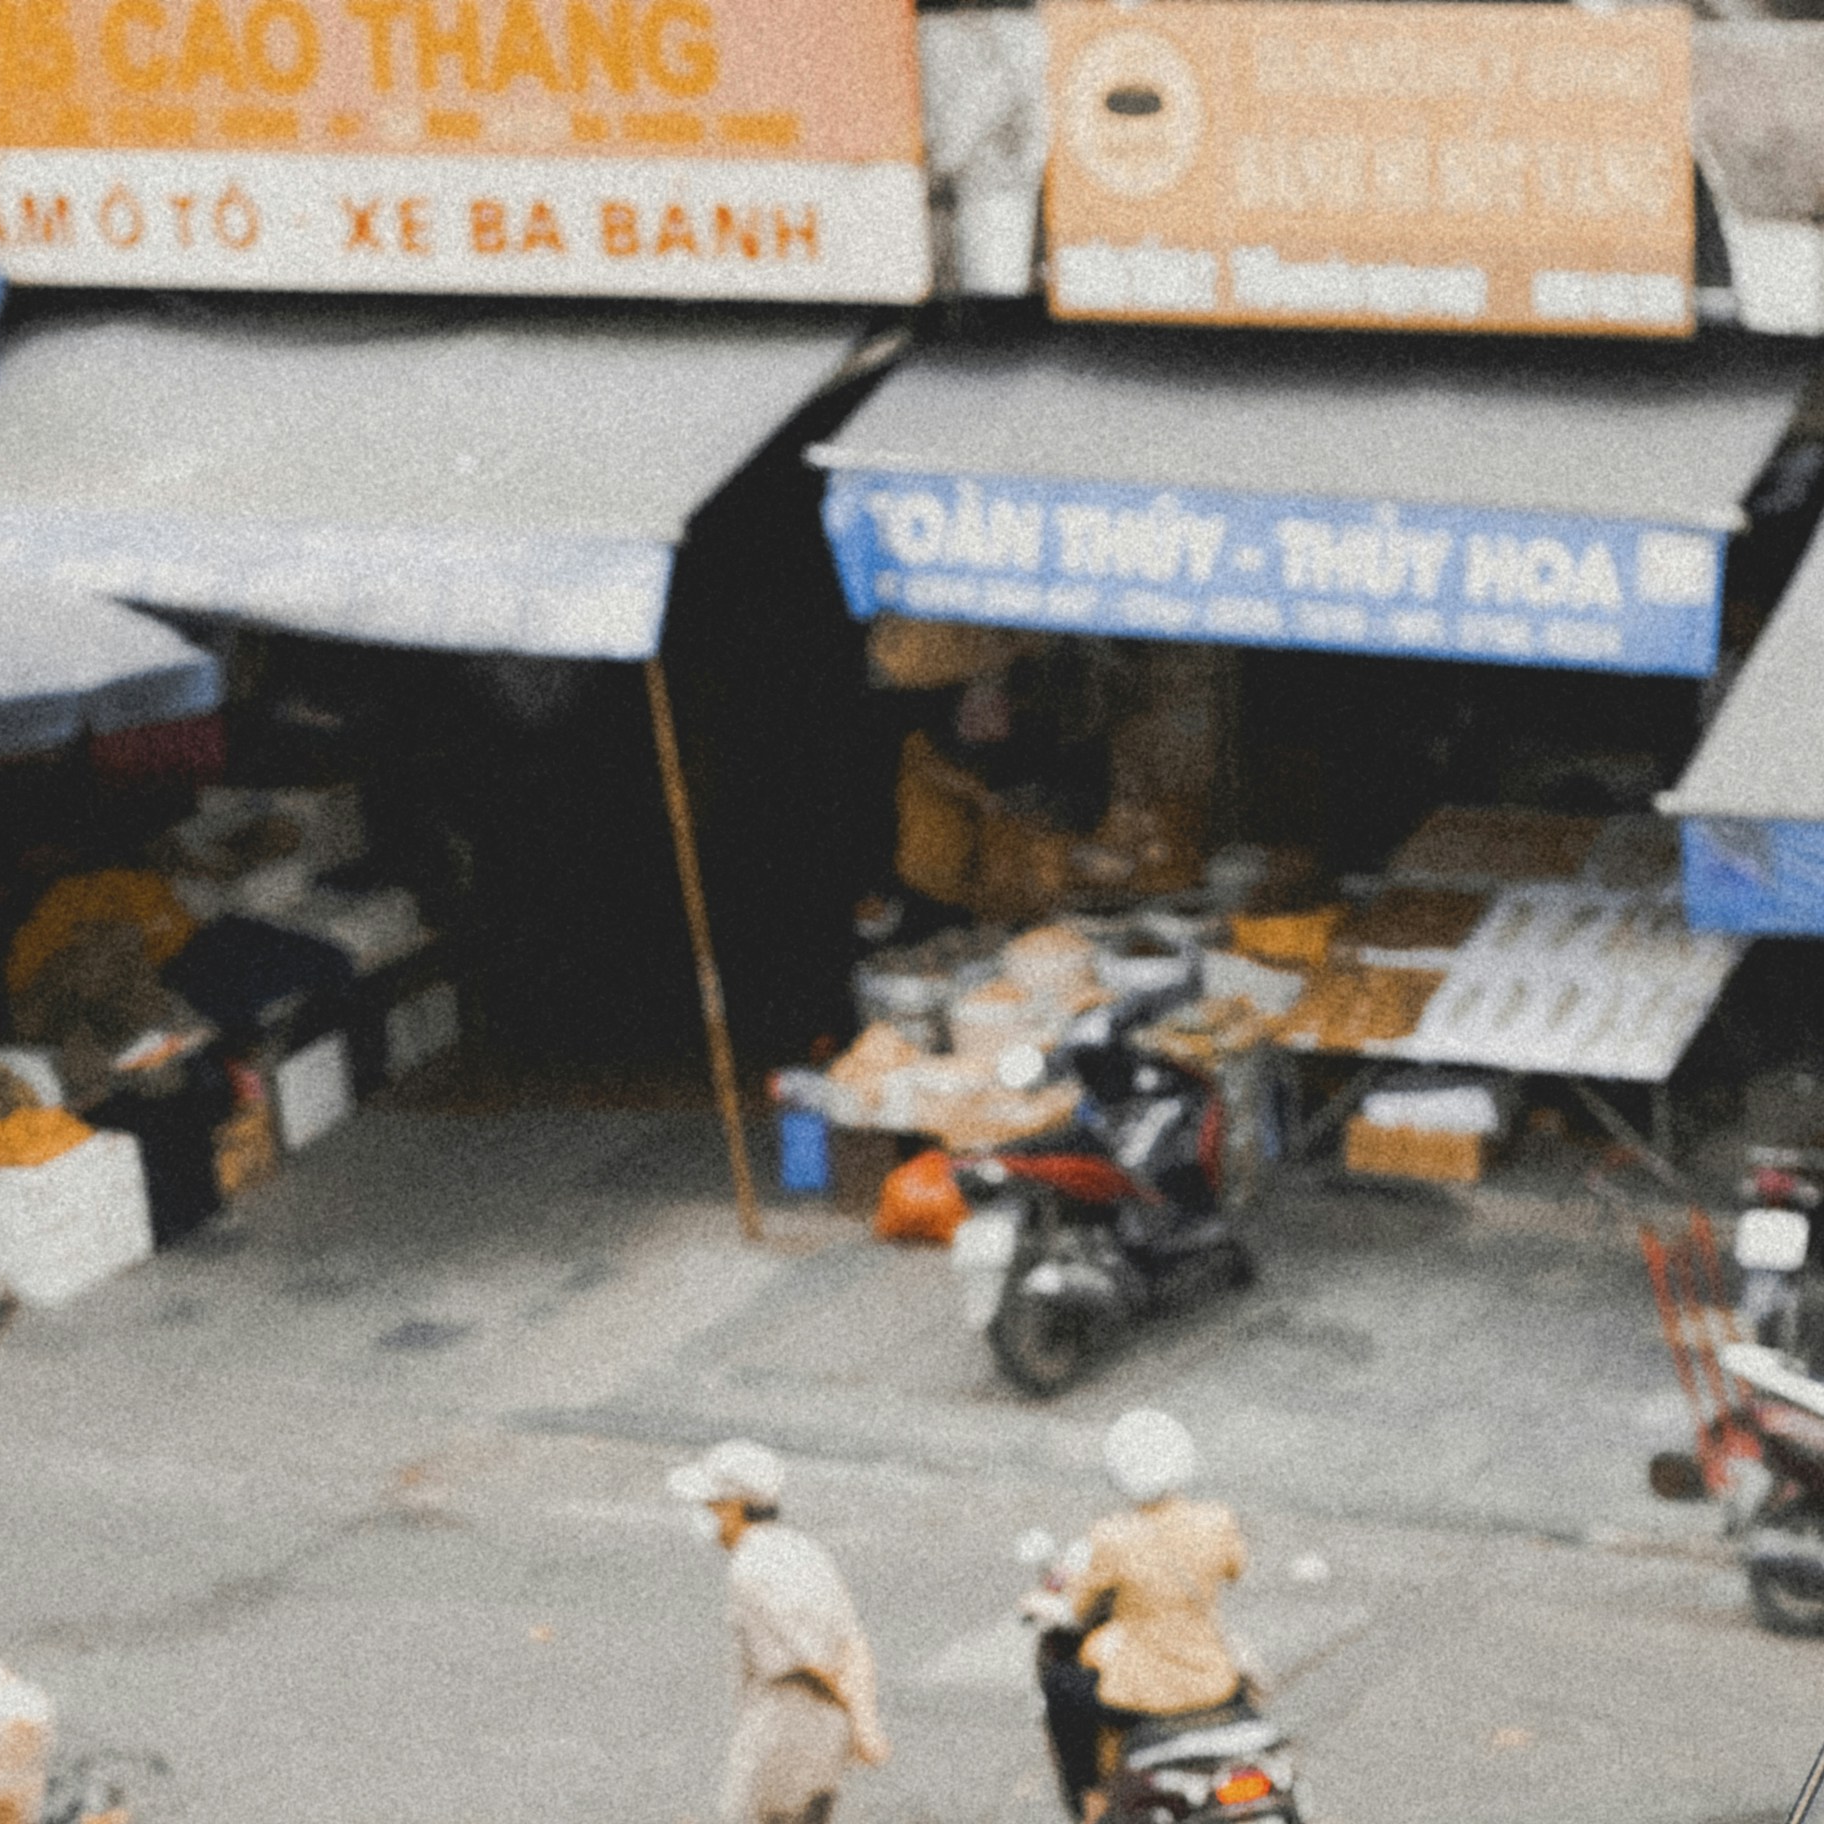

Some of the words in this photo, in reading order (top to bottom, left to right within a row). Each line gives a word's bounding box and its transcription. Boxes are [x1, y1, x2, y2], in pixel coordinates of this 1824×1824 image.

[102, 0, 321, 94] CAO
[341, 195, 434, 258] XE
[466, 195, 569, 258] BA
[1463, 533, 1623, 613] HOA
